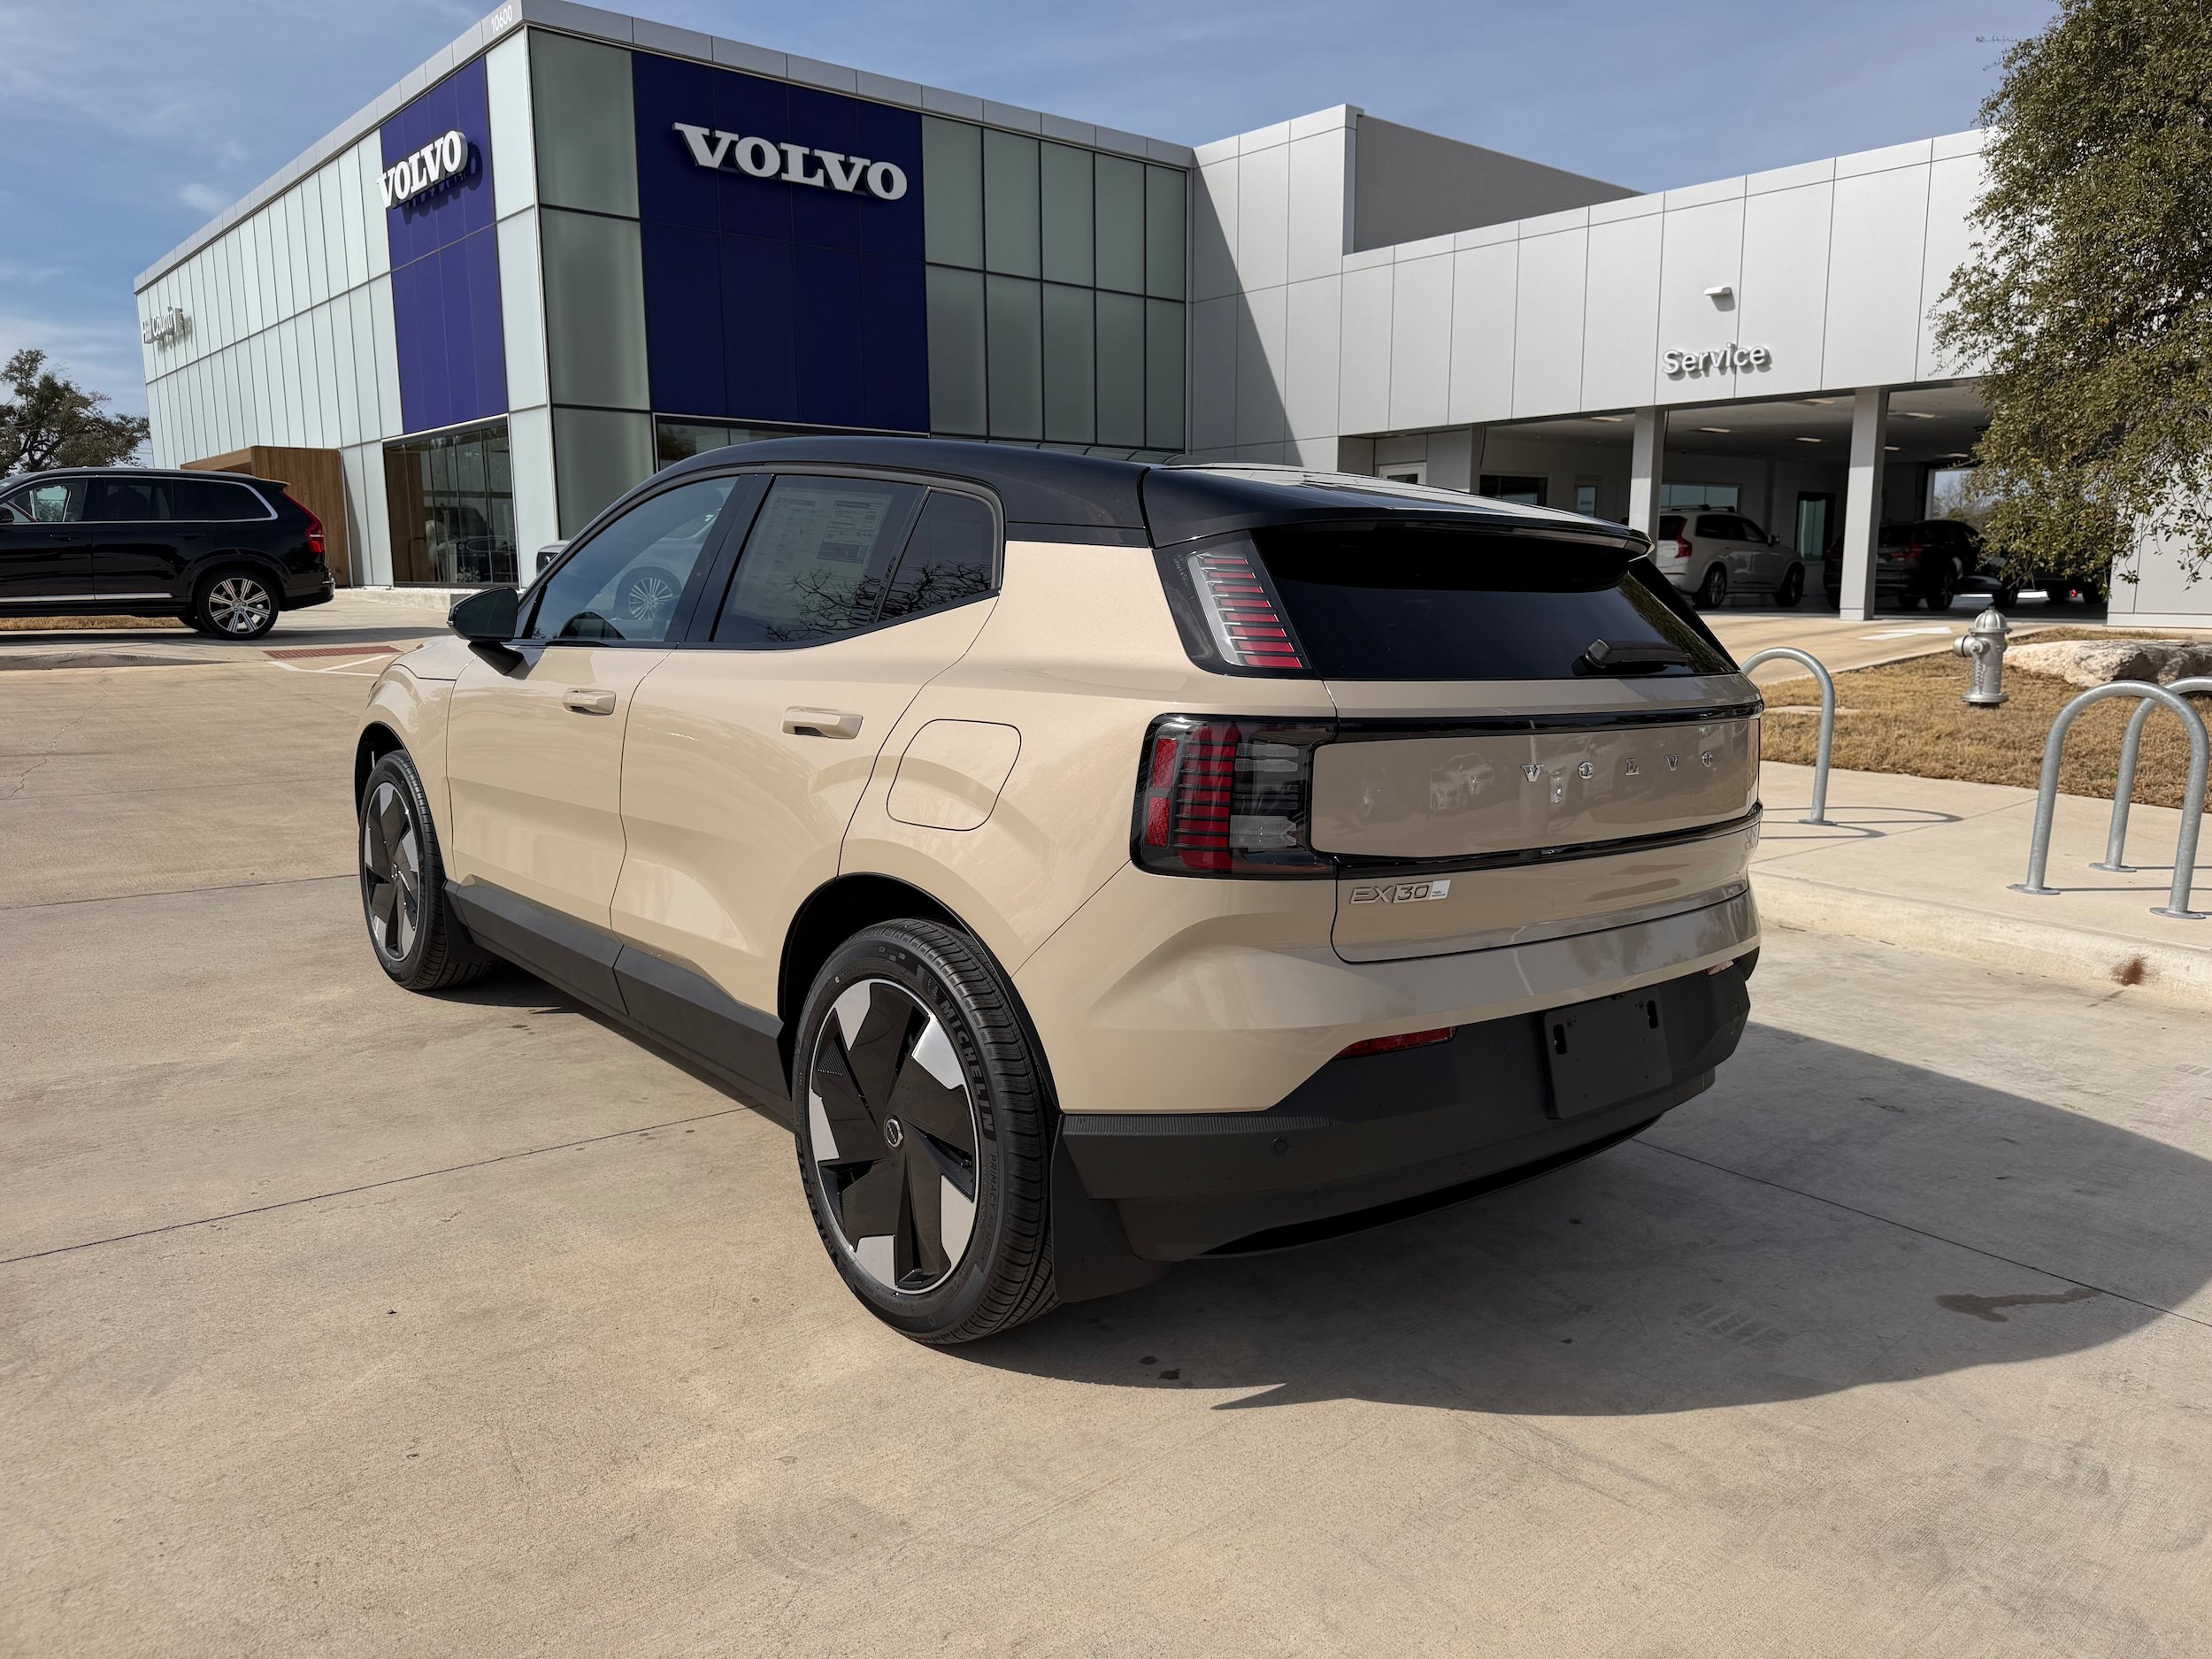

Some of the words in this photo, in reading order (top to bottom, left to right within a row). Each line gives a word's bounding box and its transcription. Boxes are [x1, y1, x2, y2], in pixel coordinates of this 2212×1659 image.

[491, 4, 513, 34] 10600
[376, 130, 465, 209] VOLVO
[672, 122, 908, 200] VOLVO
[1663, 342, 1767, 373] Service
[1521, 750, 1714, 782] VOLVO
[1349, 885, 1430, 904] EX30
[939, 999, 995, 1131] MICHELIN
